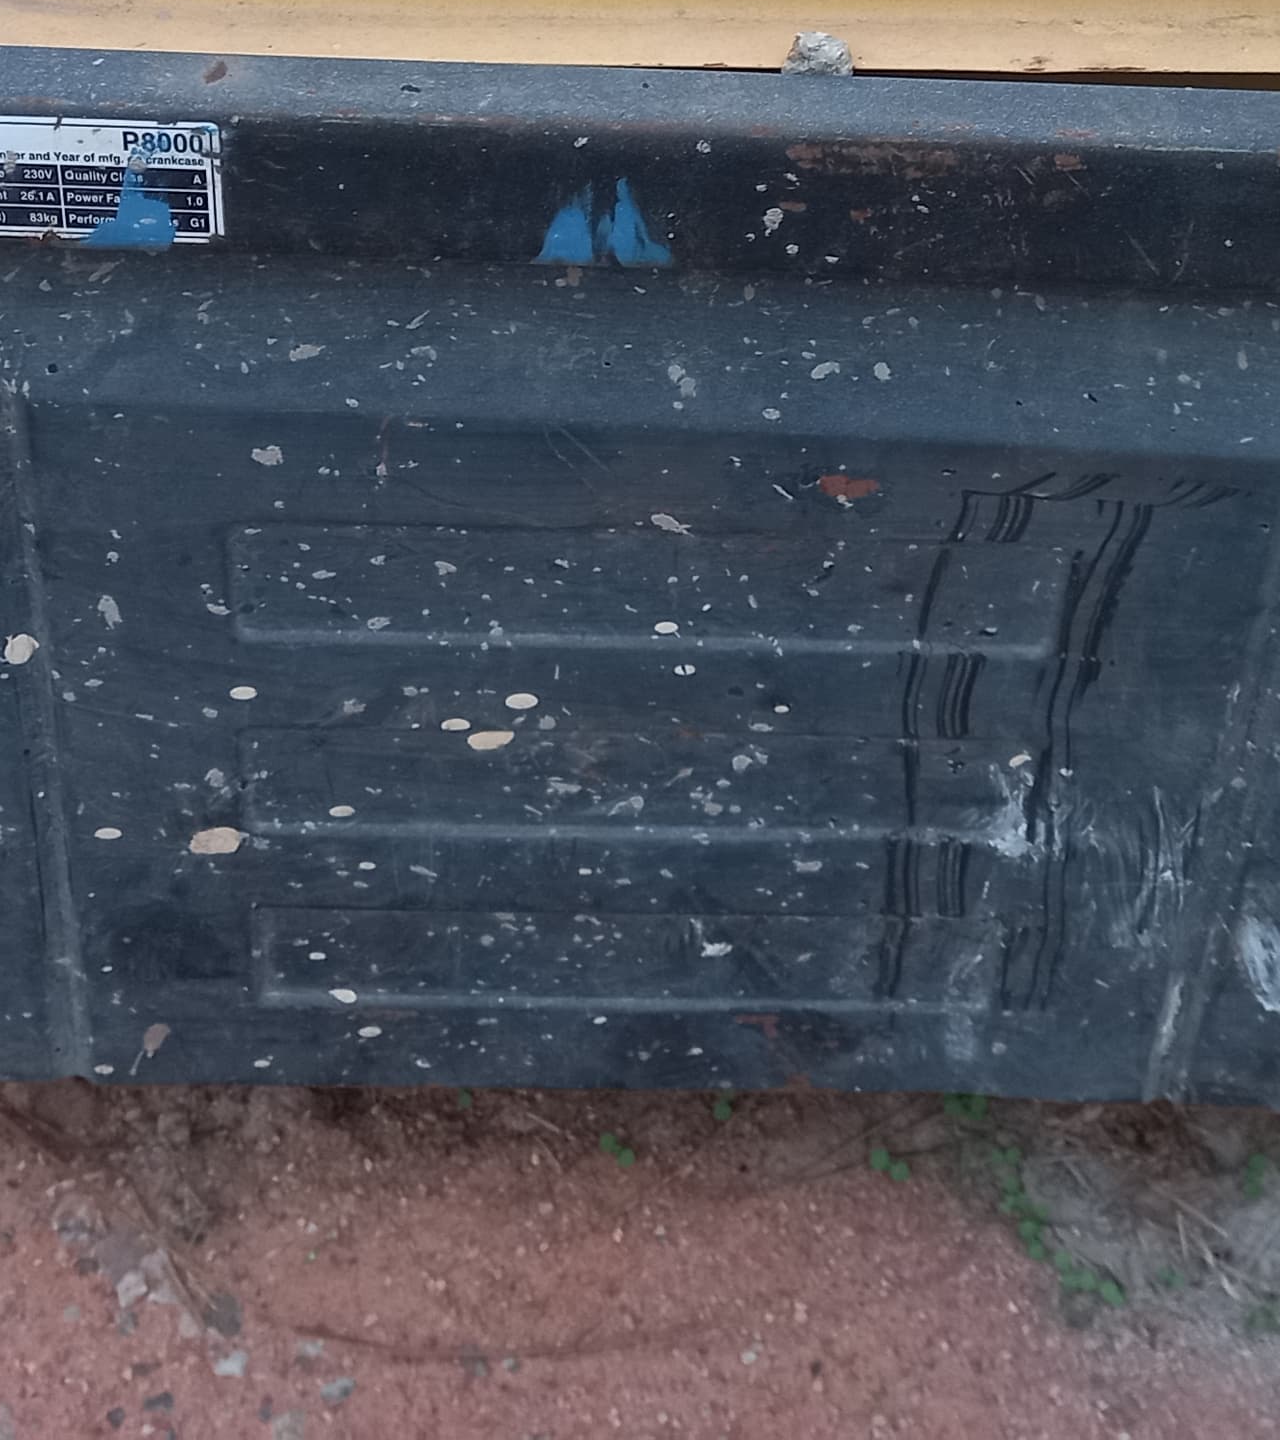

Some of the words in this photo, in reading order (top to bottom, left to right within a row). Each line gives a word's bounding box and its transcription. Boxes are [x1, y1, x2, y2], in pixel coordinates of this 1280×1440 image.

[122, 131, 204, 153] P8000
[28, 151, 51, 161] and
[53, 151, 81, 163] Year
[83, 152, 96, 162] of
[98, 153, 124, 164] mfg.
[146, 155, 205, 166] crankcase
[23, 169, 53, 180] 230V
[64, 170, 107, 184] Quality
[110, 171, 144, 183] Clss
[192, 174, 202, 185] A
[66, 192, 105, 203] Power
[186, 196, 204, 206] 1.0
[29, 212, 58, 224] 83kg
[189, 217, 206, 228] G1
